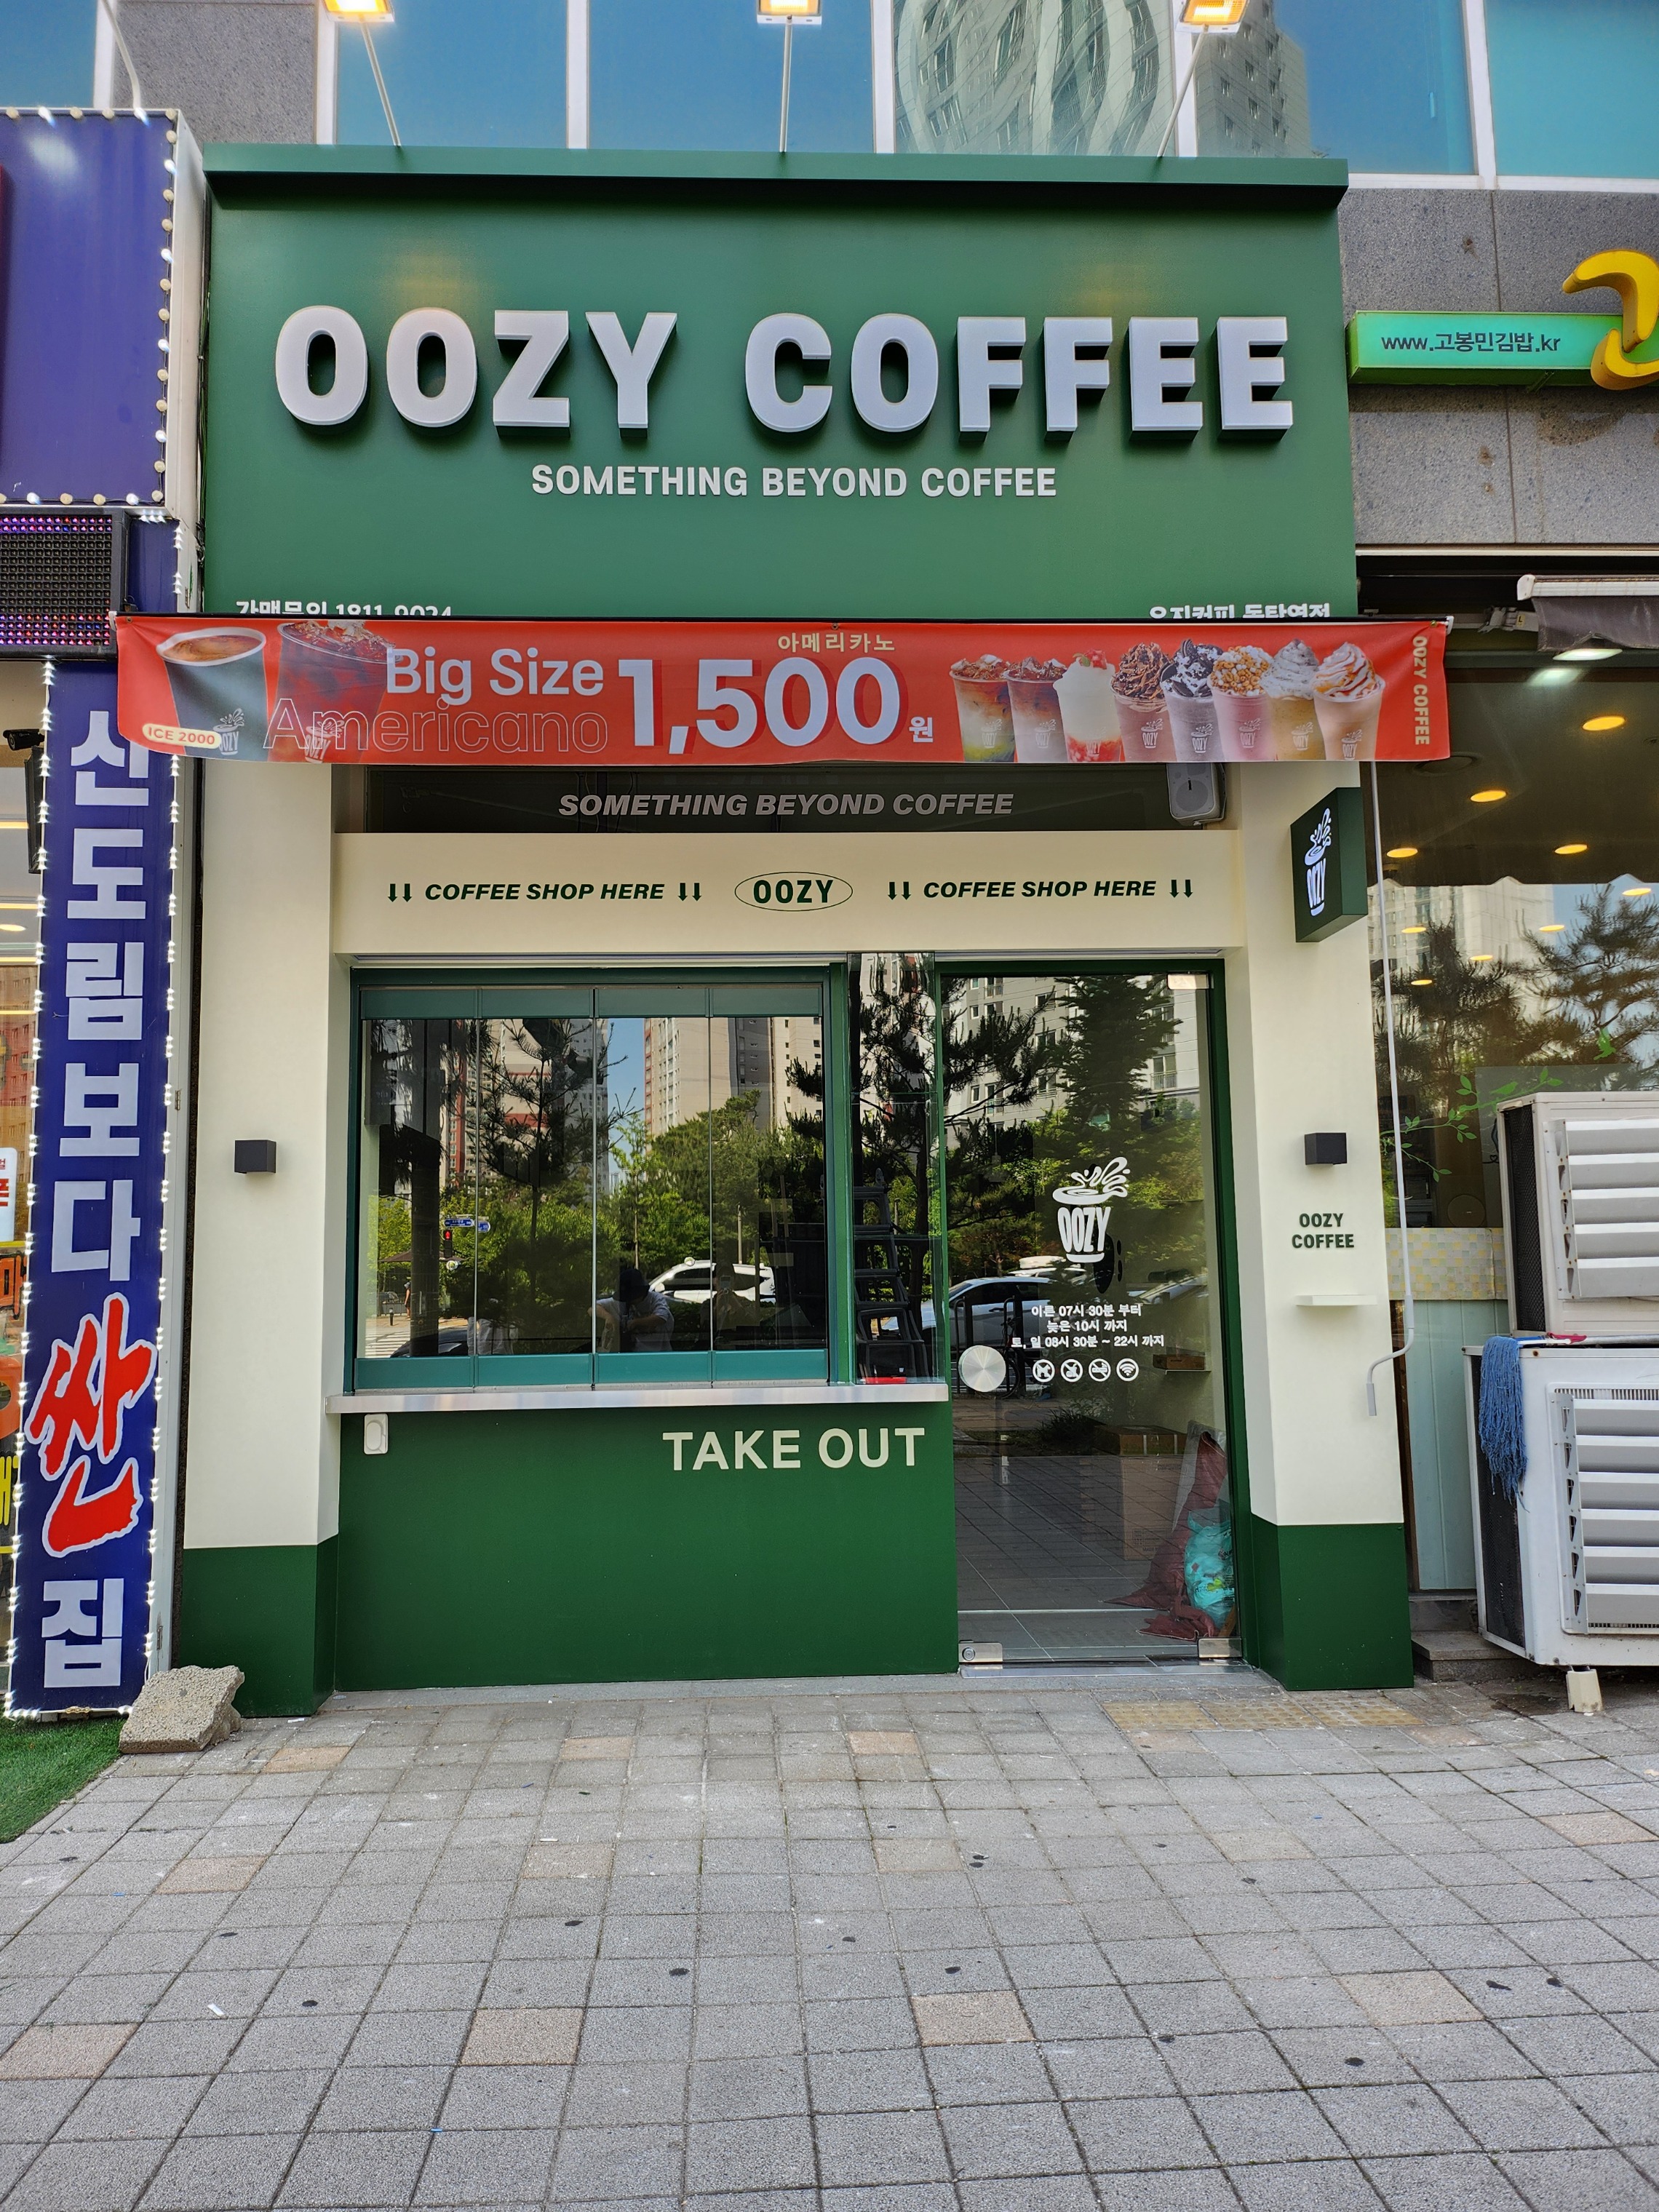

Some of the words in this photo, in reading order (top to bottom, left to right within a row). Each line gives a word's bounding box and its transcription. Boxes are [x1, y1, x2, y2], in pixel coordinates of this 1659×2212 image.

[1381, 332, 1561, 352] www.고봉민김밥.kr
[275, 305, 680, 431] OOZY
[744, 312, 1294, 434] COFFEE
[532, 464, 747, 496] SOMETHING
[763, 467, 907, 497] BEYOND
[921, 467, 1057, 497] COFFEE
[778, 632, 895, 653] 아메리카노
[1412, 636, 1428, 680] OOZY
[386, 647, 472, 705] Big
[490, 647, 604, 696] Size
[1413, 684, 1430, 745] COFFEE
[148, 726, 175, 741] ICE
[178, 732, 215, 745] 2000
[263, 698, 608, 754] Americano
[1142, 732, 1158, 747] OOZY
[1192, 737, 1208, 751] OOZY
[558, 794, 747, 816] SOMETHING
[755, 794, 885, 816] BEYOND
[892, 793, 1015, 815] COFFEE
[425, 883, 521, 901] COFFEE
[526, 883, 594, 901] SHOP
[600, 883, 665, 900] HERE
[752, 879, 835, 904] OOZY
[923, 881, 1017, 899] COFFEE
[1021, 880, 1089, 898] SHOP
[1094, 880, 1157, 897] HERE
[1306, 857, 1326, 909] OOZY
[1057, 1206, 1112, 1253] OOZY
[1299, 1213, 1344, 1228] OOZY
[1292, 1234, 1355, 1249] COFFEE
[1031, 1305, 1055, 1318] 이른
[1059, 1304, 1084, 1318] 07시
[1089, 1304, 1115, 1317] 30분
[1118, 1303, 1142, 1317] 부터
[1046, 1320, 1071, 1333] 늦은
[1074, 1319, 1099, 1332] 10시
[1103, 1318, 1127, 1332] 까지
[1011, 1337, 1027, 1349] 토,
[1030, 1335, 1041, 1348] 일
[1044, 1335, 1069, 1348] 08시
[1073, 1335, 1098, 1348] 30분
[1113, 1334, 1138, 1348] 22시
[1141, 1334, 1164, 1347] 까지
[662, 1429, 800, 1471] TAKE
[819, 1427, 925, 1468] OUT
